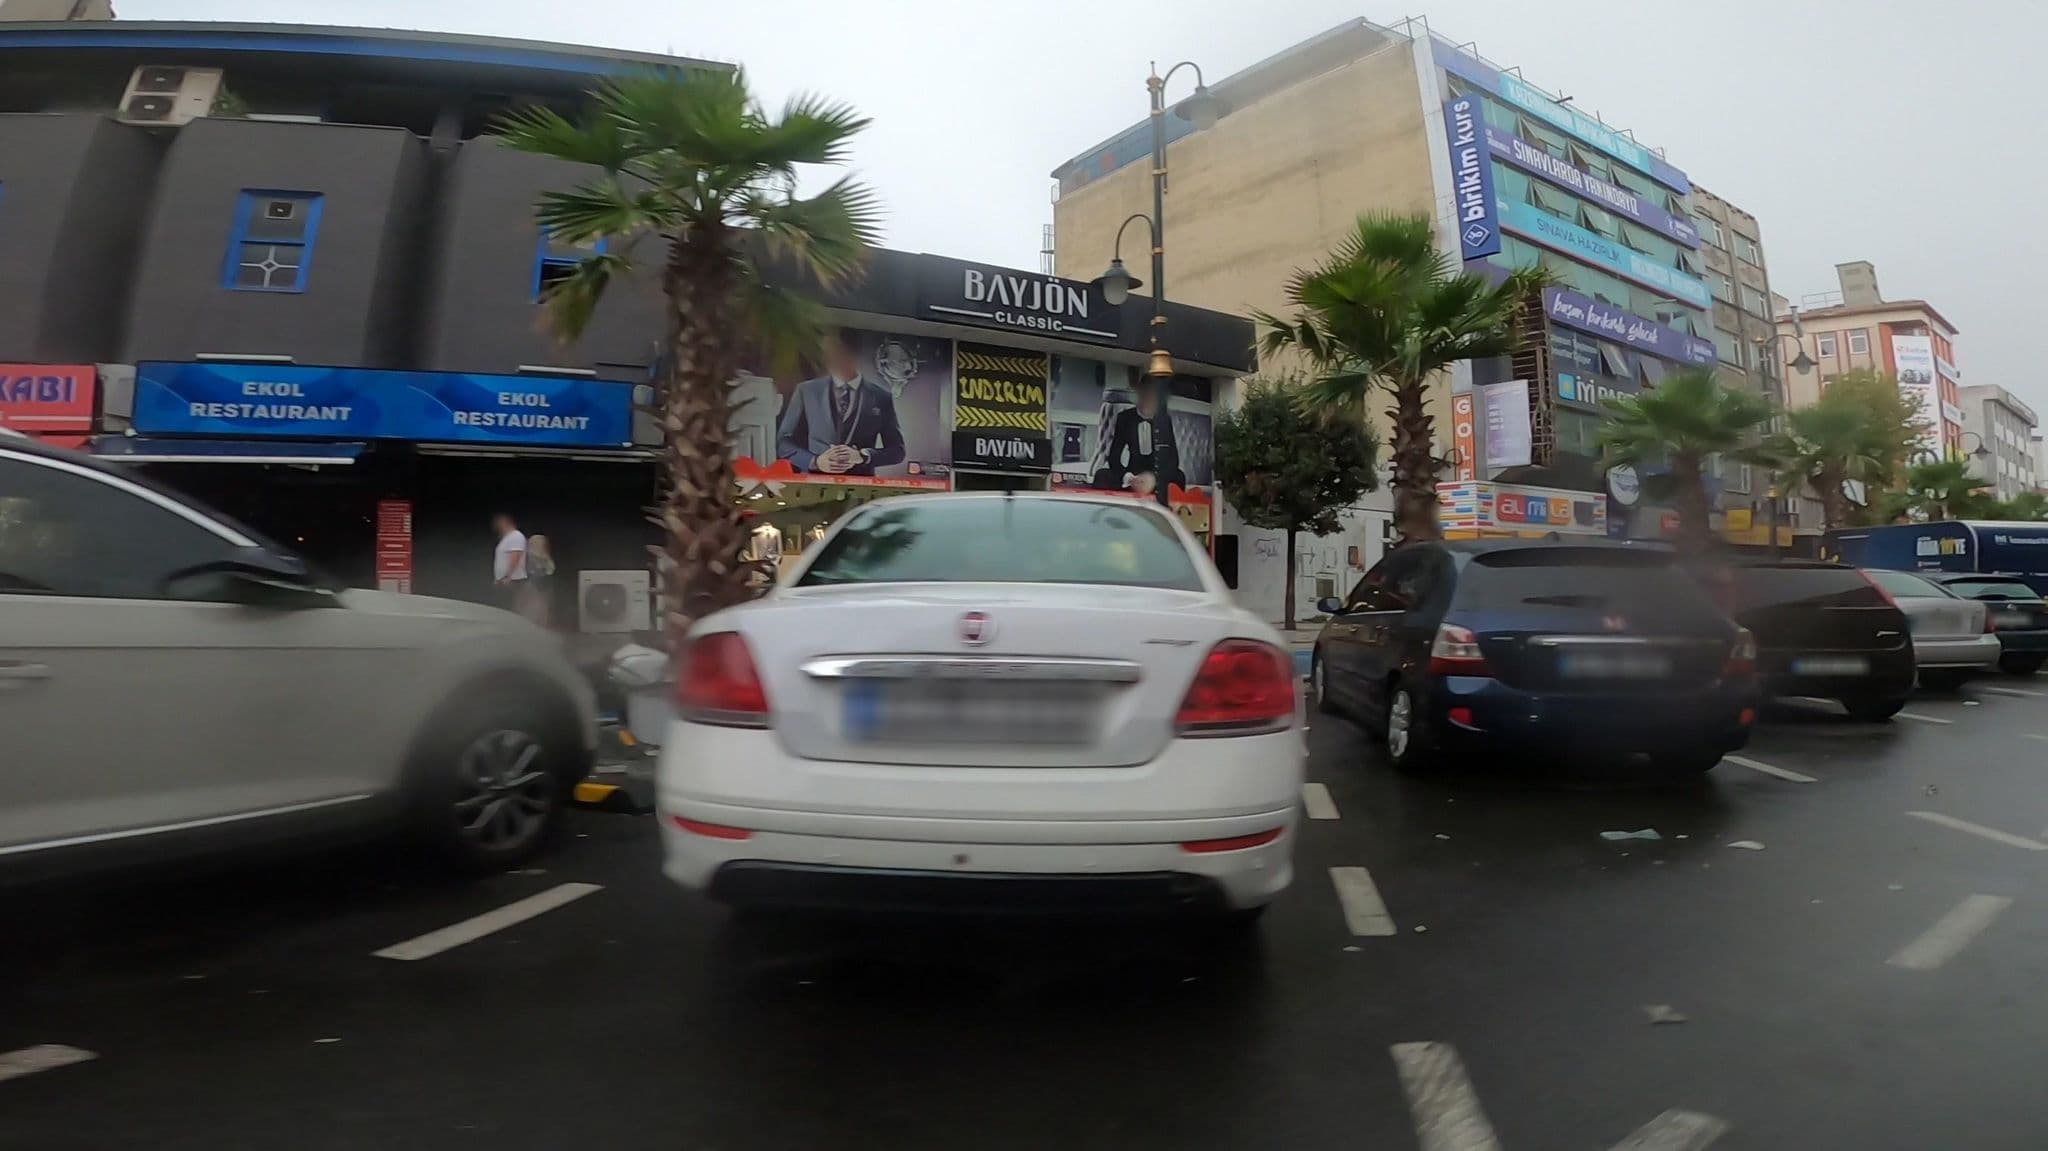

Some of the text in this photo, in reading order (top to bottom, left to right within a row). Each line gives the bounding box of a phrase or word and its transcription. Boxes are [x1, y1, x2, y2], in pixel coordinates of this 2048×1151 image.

[1453, 100, 1486, 223] birikim kurs
[1512, 139, 1583, 189] SINAVLARDA
[1583, 174, 1640, 216] YANINDAYIZ
[964, 269, 1088, 319] BAYJÖN
[242, 381, 305, 397] EKOL
[498, 391, 551, 408] EKOL
[190, 402, 352, 421] RESTAURANT
[453, 410, 590, 430] RESTAURANT
[975, 437, 1035, 459] BAYJÖN
